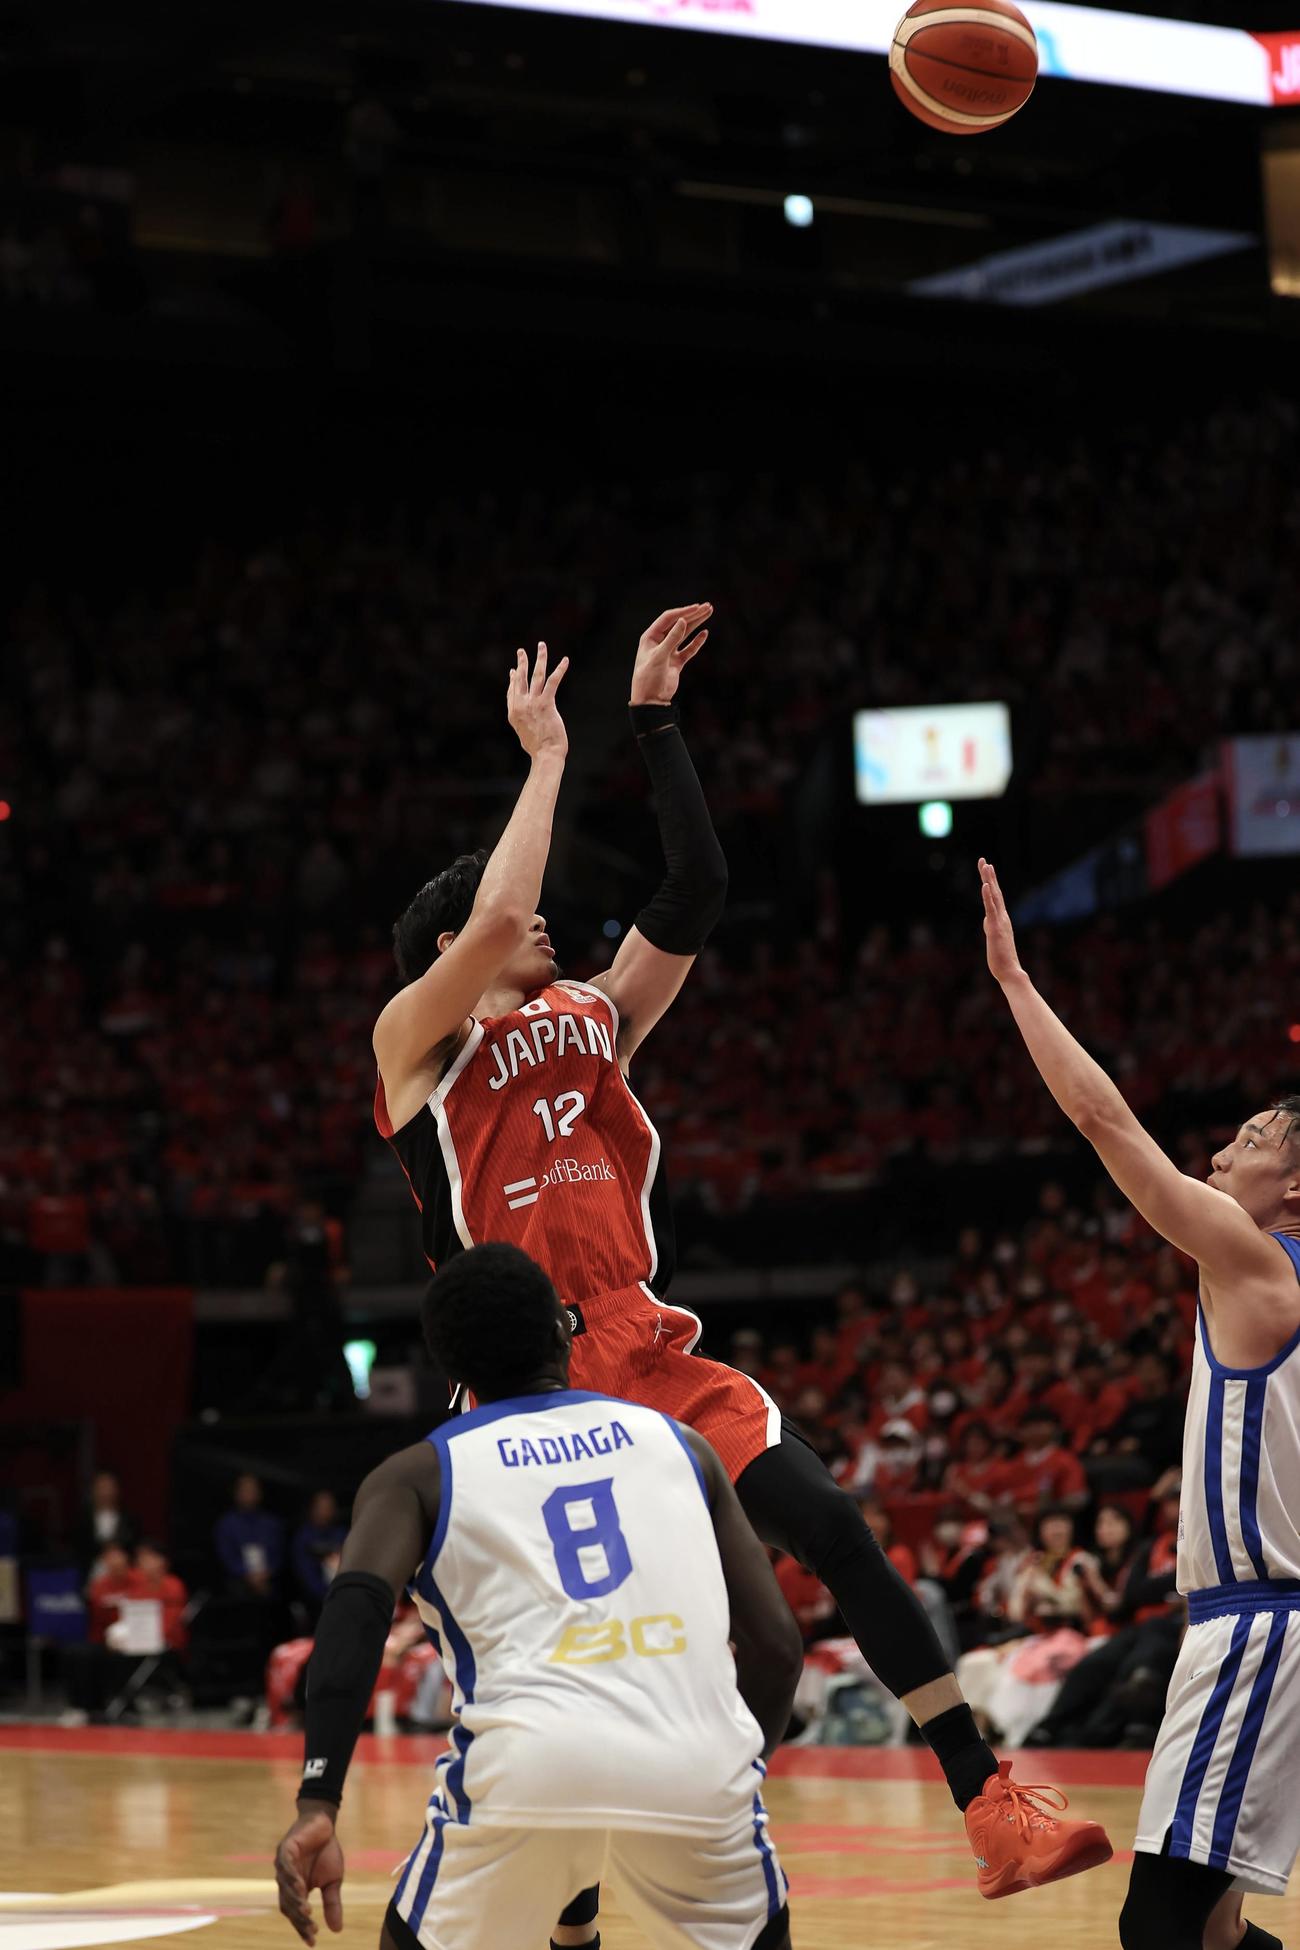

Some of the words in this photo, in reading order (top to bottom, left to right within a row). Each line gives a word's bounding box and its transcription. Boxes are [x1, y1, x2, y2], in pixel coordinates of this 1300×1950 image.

[488, 1014, 613, 1091] JAPAN
[532, 1089, 586, 1143] 12
[497, 1421, 634, 1467] GADIAGA
[541, 1476, 633, 1600] 8
[548, 1613, 687, 1664] BC
